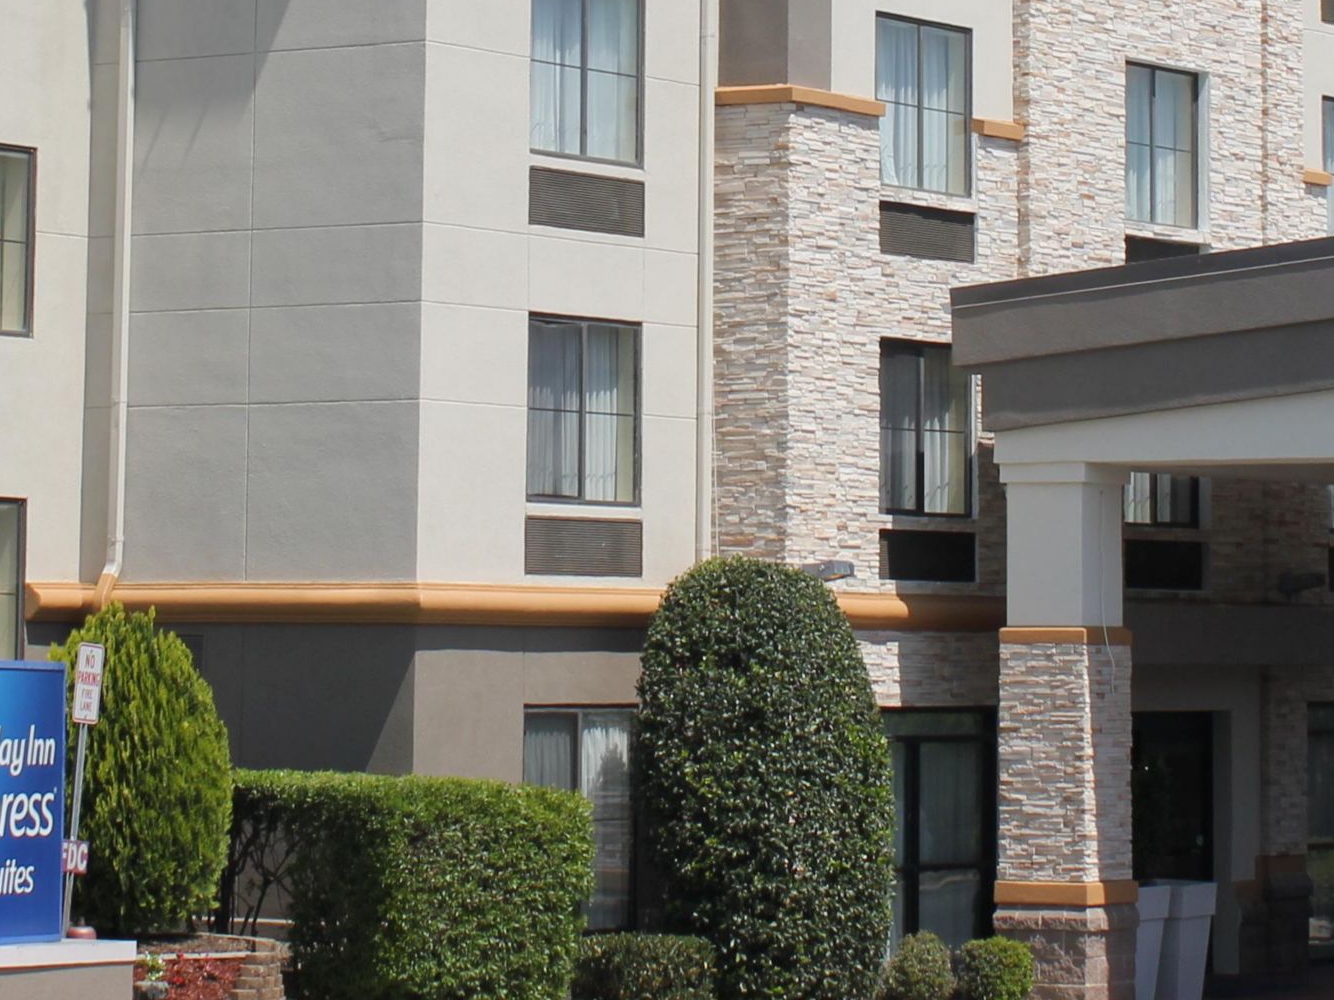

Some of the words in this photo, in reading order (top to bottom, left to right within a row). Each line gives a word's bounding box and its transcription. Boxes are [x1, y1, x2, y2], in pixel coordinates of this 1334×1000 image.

[85, 654, 96, 669] NO
[78, 671, 100, 687] PARKING
[81, 688, 93, 700] FIRE
[79, 701, 92, 712] LANE
[27, 724, 55, 766] Inn
